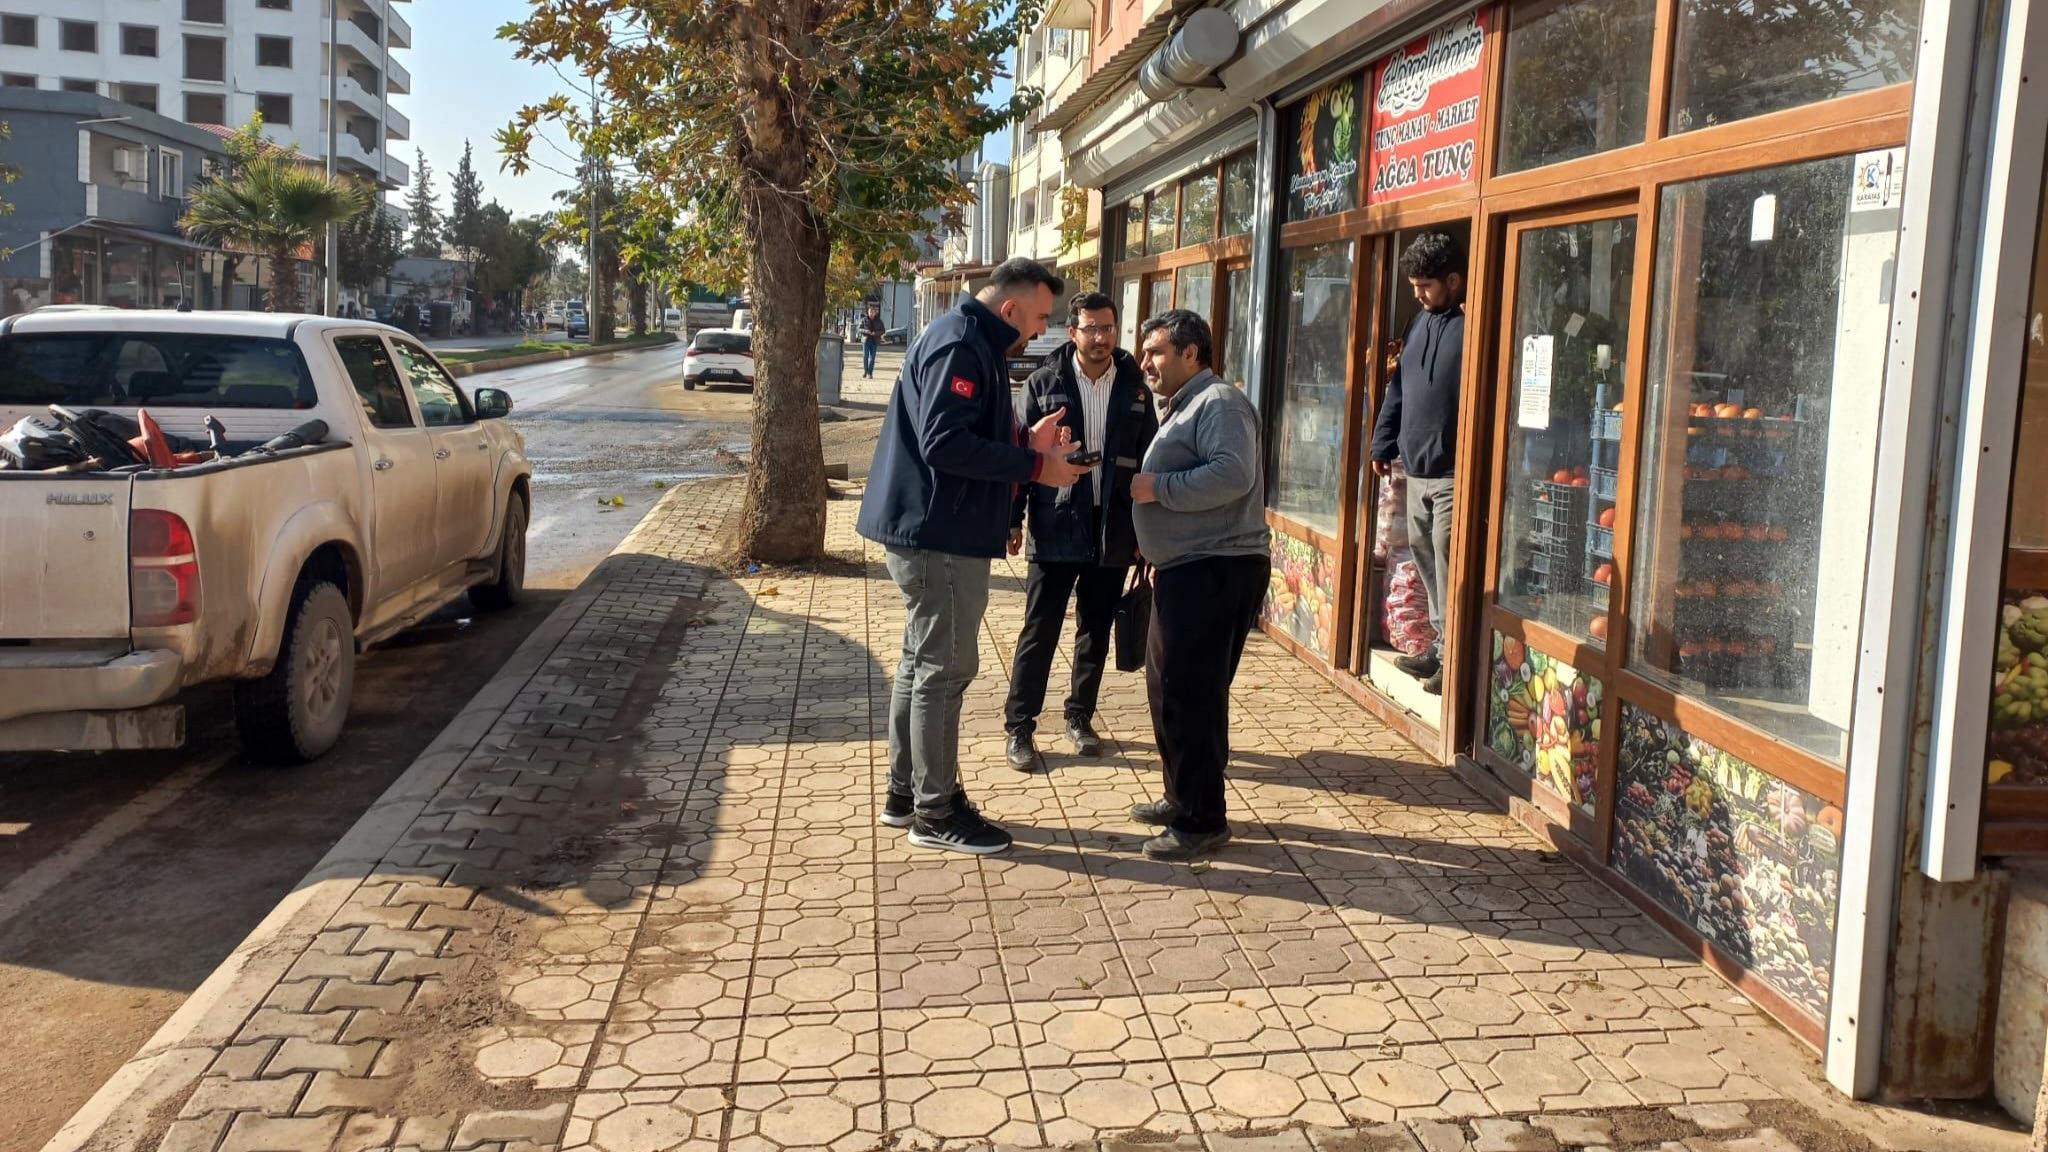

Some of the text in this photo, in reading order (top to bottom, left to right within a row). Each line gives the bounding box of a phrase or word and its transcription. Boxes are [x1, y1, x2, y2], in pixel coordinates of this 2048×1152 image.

[1374, 96, 1479, 151] TUNÇ MANAV MARKET
[1373, 140, 1474, 192] AĞCA TUNÇ
